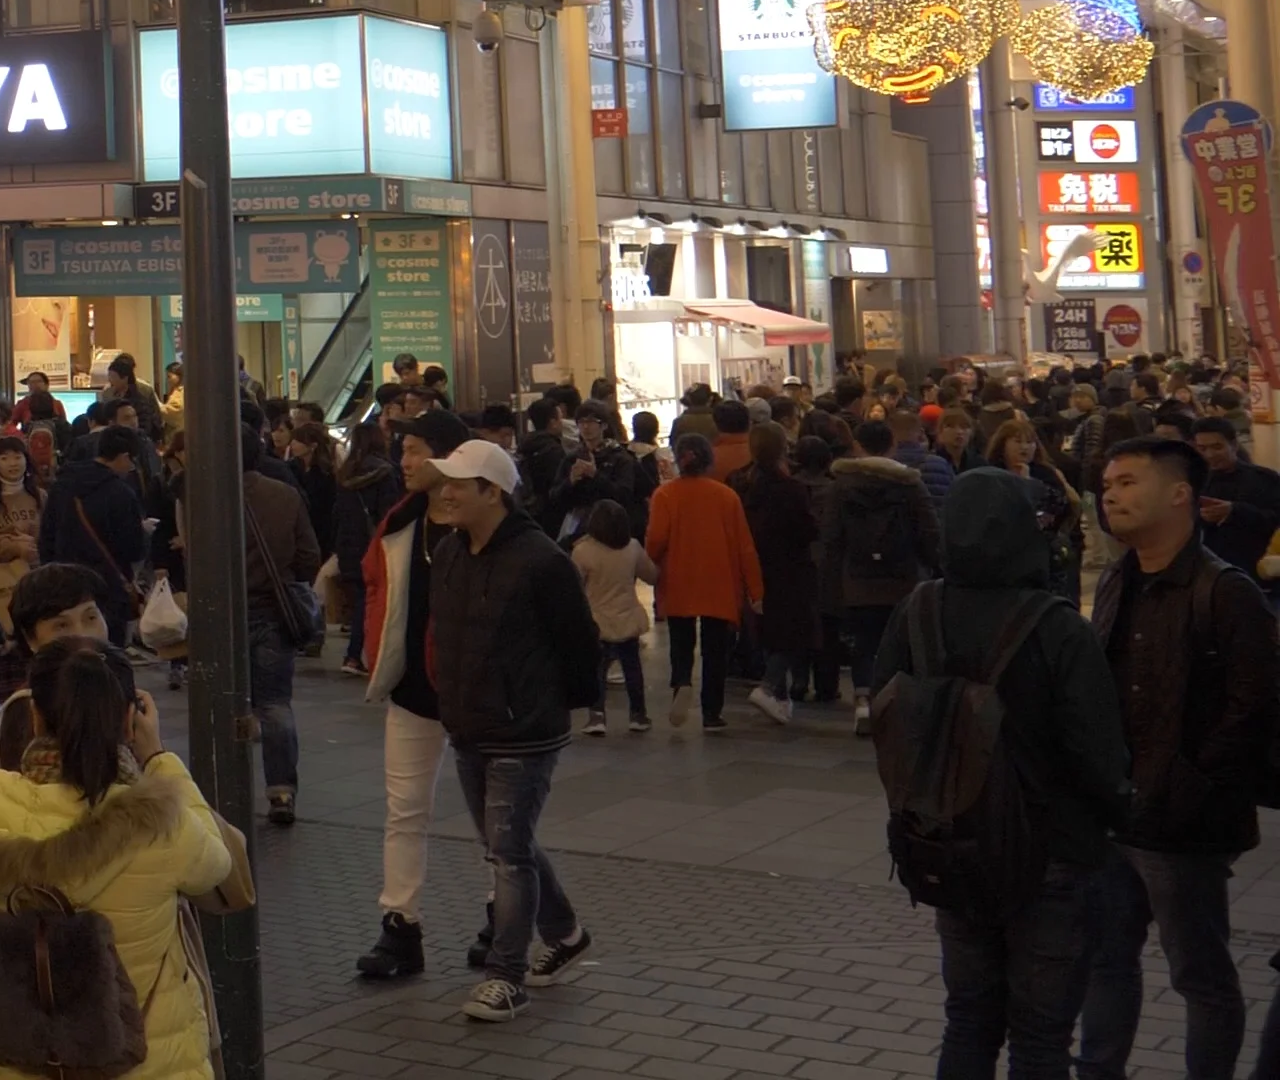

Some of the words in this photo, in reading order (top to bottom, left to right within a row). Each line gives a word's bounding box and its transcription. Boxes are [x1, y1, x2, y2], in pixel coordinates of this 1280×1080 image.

[1057, 173, 1119, 204] 免税
[151, 191, 178, 213] 3F
[308, 190, 371, 209] store
[59, 239, 145, 256] @cosme
[398, 234, 418, 249] 3F
[1100, 230, 1133, 267] 薬
[28, 250, 51, 268] 3F
[61, 260, 133, 274] TSUTAYA
[387, 270, 431, 283] store
[1054, 308, 1087, 324] 24H
